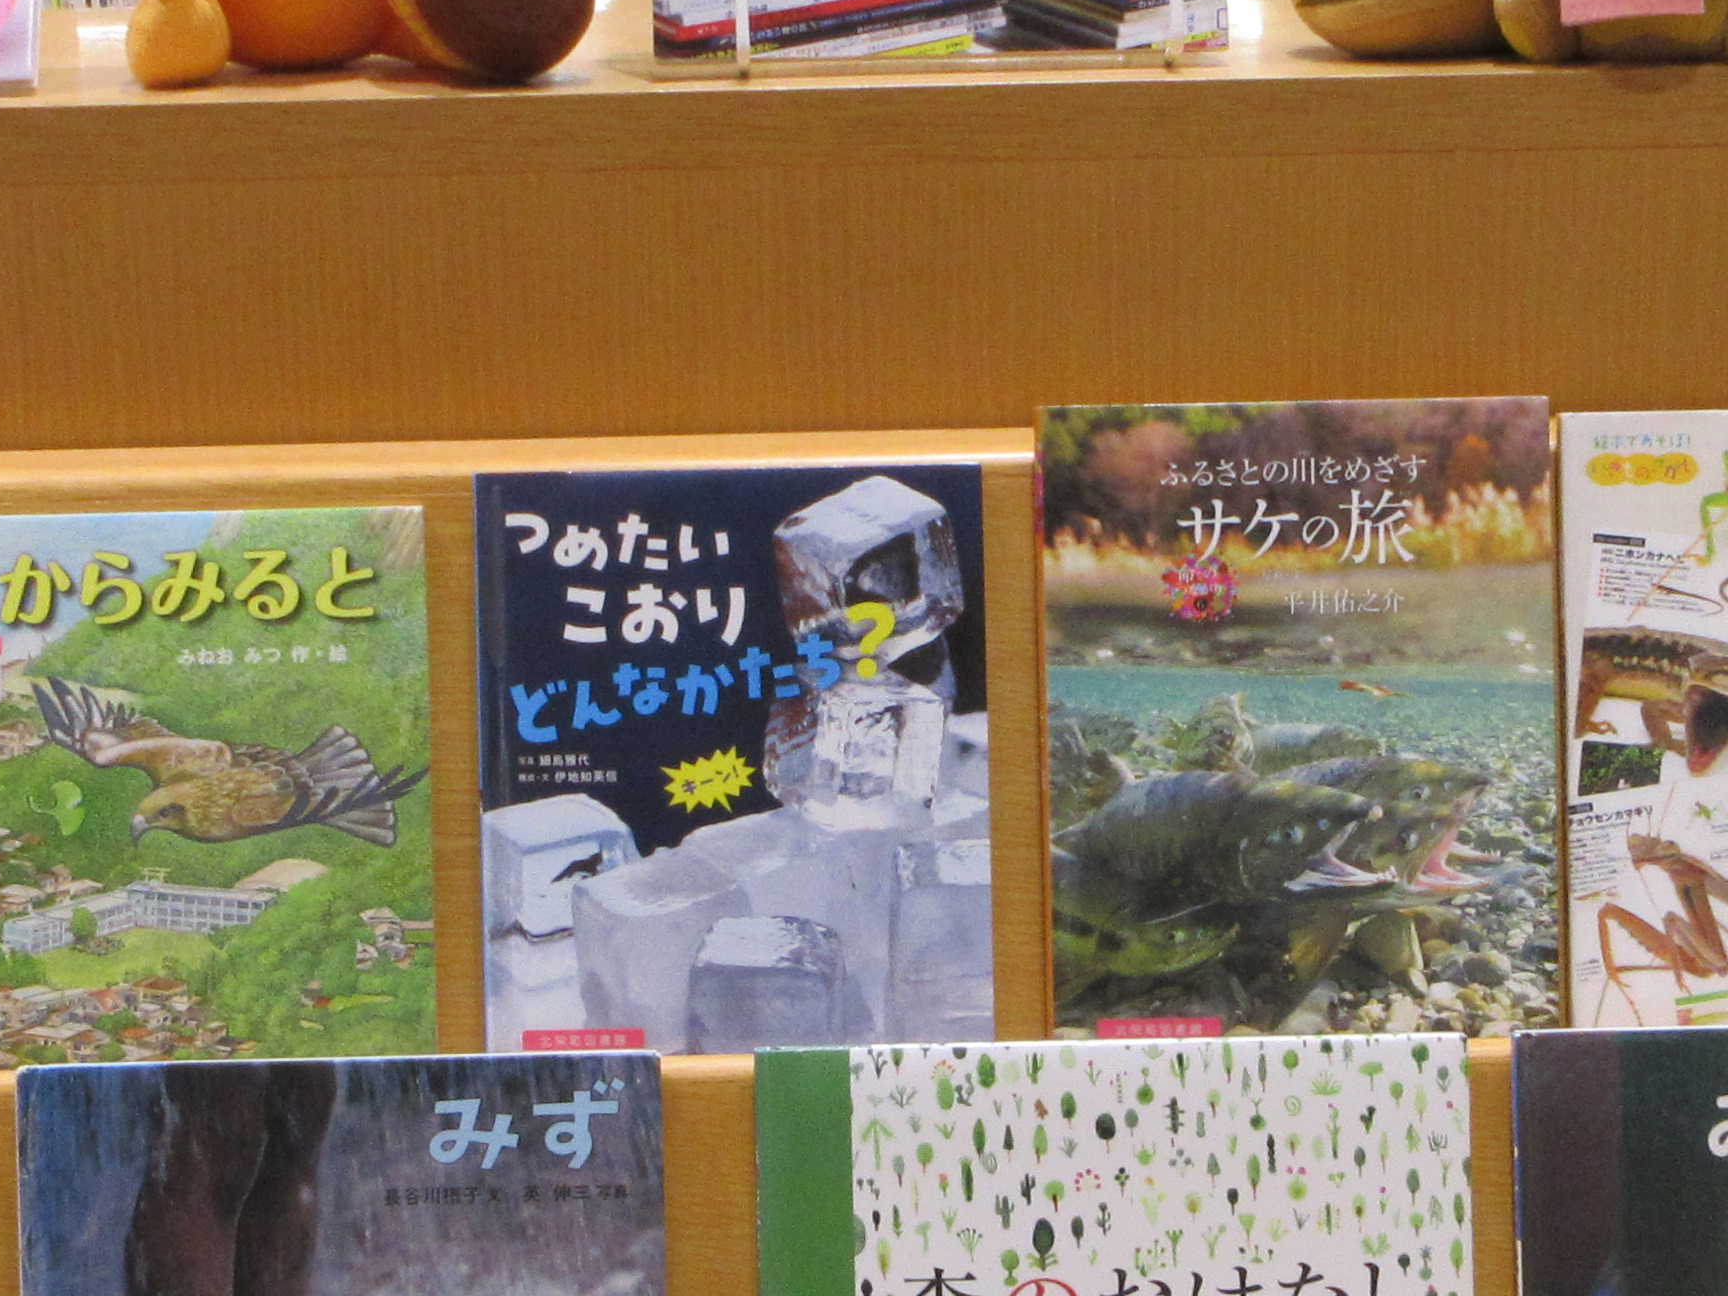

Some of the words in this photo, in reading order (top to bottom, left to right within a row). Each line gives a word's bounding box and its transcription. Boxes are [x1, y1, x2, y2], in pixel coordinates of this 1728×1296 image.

[1159, 454, 1428, 487] ふるさとの川をめざす
[504, 512, 730, 572] つめたい
[1176, 488, 1416, 565] サケの旅
[563, 583, 747, 646] こおり
[1283, 587, 1406, 615] 平井佑之介
[177, 647, 235, 666] みねお
[509, 600, 895, 743] どんなかたち?
[554, 770, 618, 784] 伊地知英信
[681, 764, 741, 796] キーン!
[428, 1077, 626, 1170] みず
